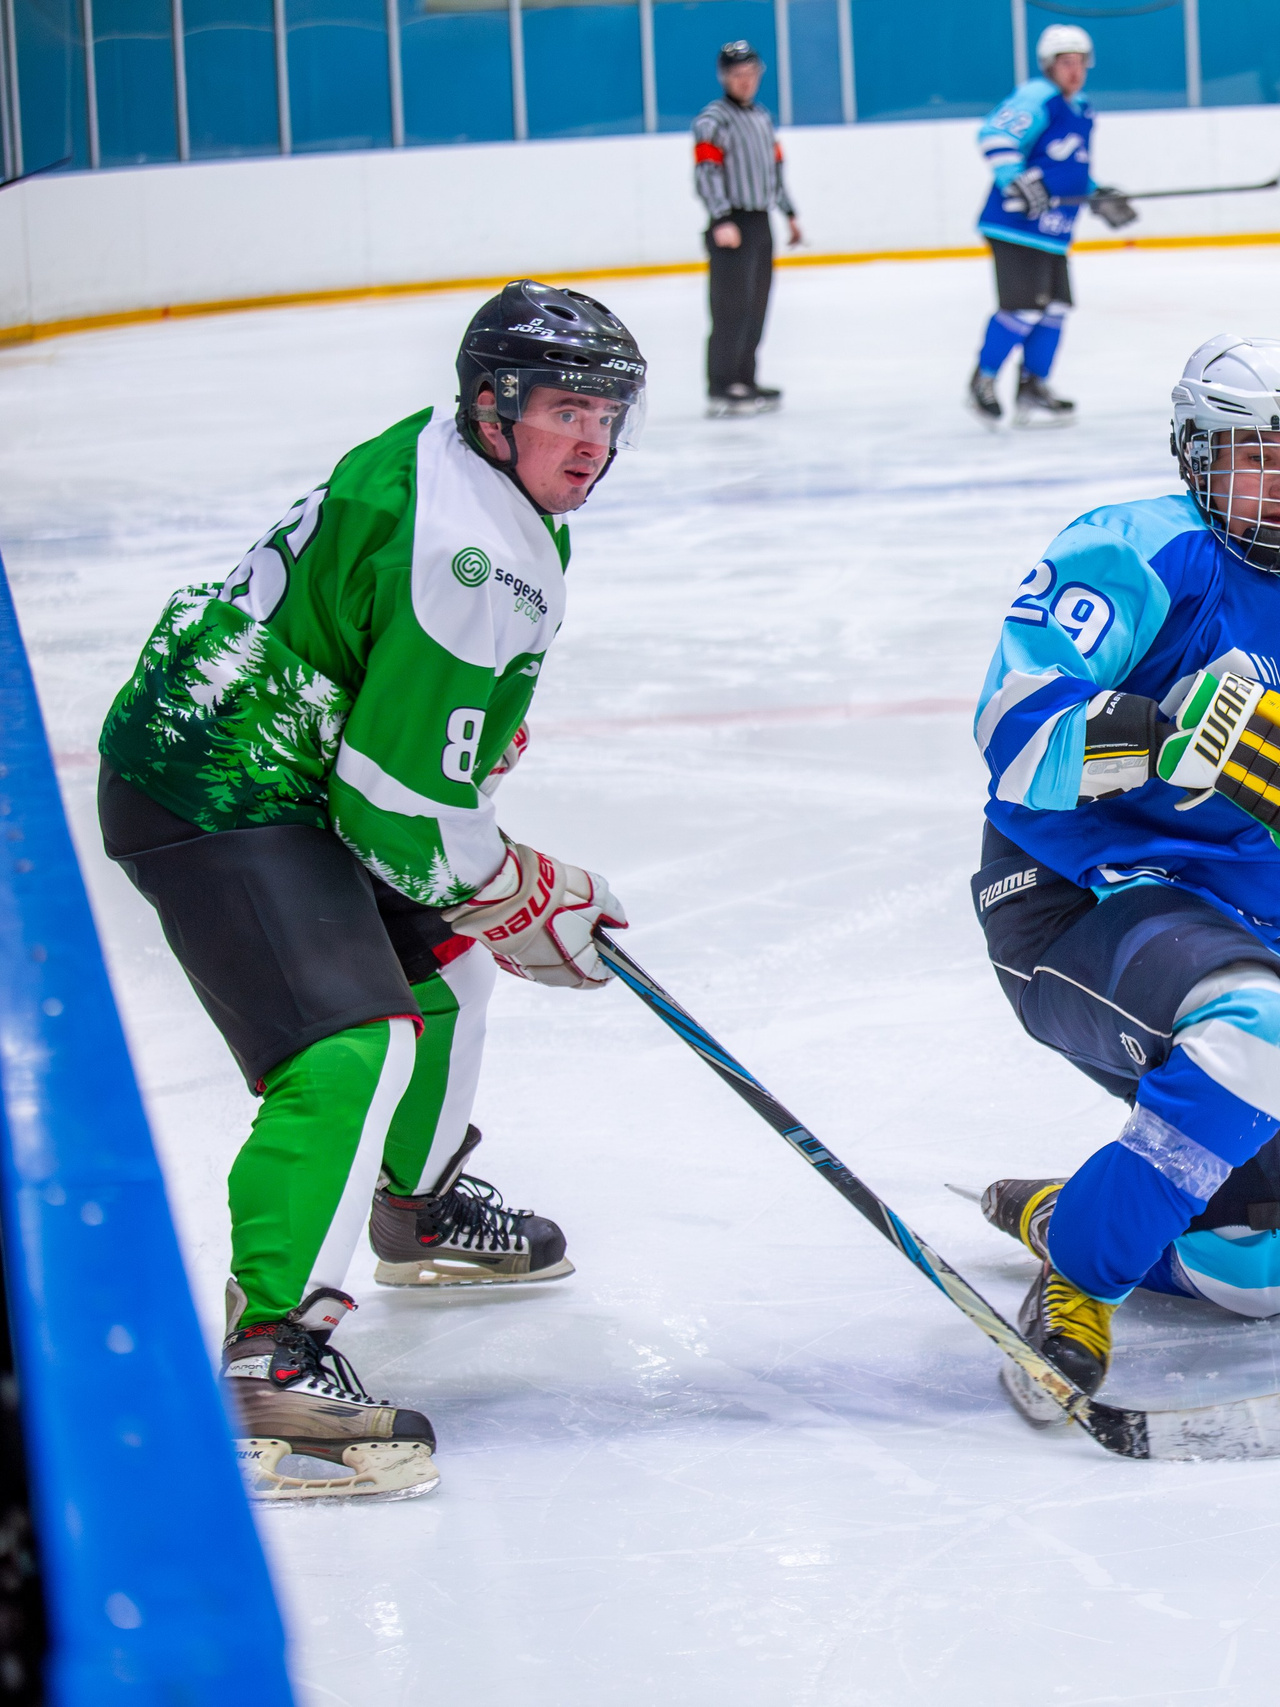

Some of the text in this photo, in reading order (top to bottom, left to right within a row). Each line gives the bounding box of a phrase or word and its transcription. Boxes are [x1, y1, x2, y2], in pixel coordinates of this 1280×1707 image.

[508, 323, 556, 337] JOFA
[600, 358, 646, 376] JOFA
[494, 567, 548, 615] segezha
[513, 597, 541, 625] group
[1004, 558, 1116, 660] 29
[441, 706, 486, 784] 8
[979, 867, 1039, 913] FLAME
